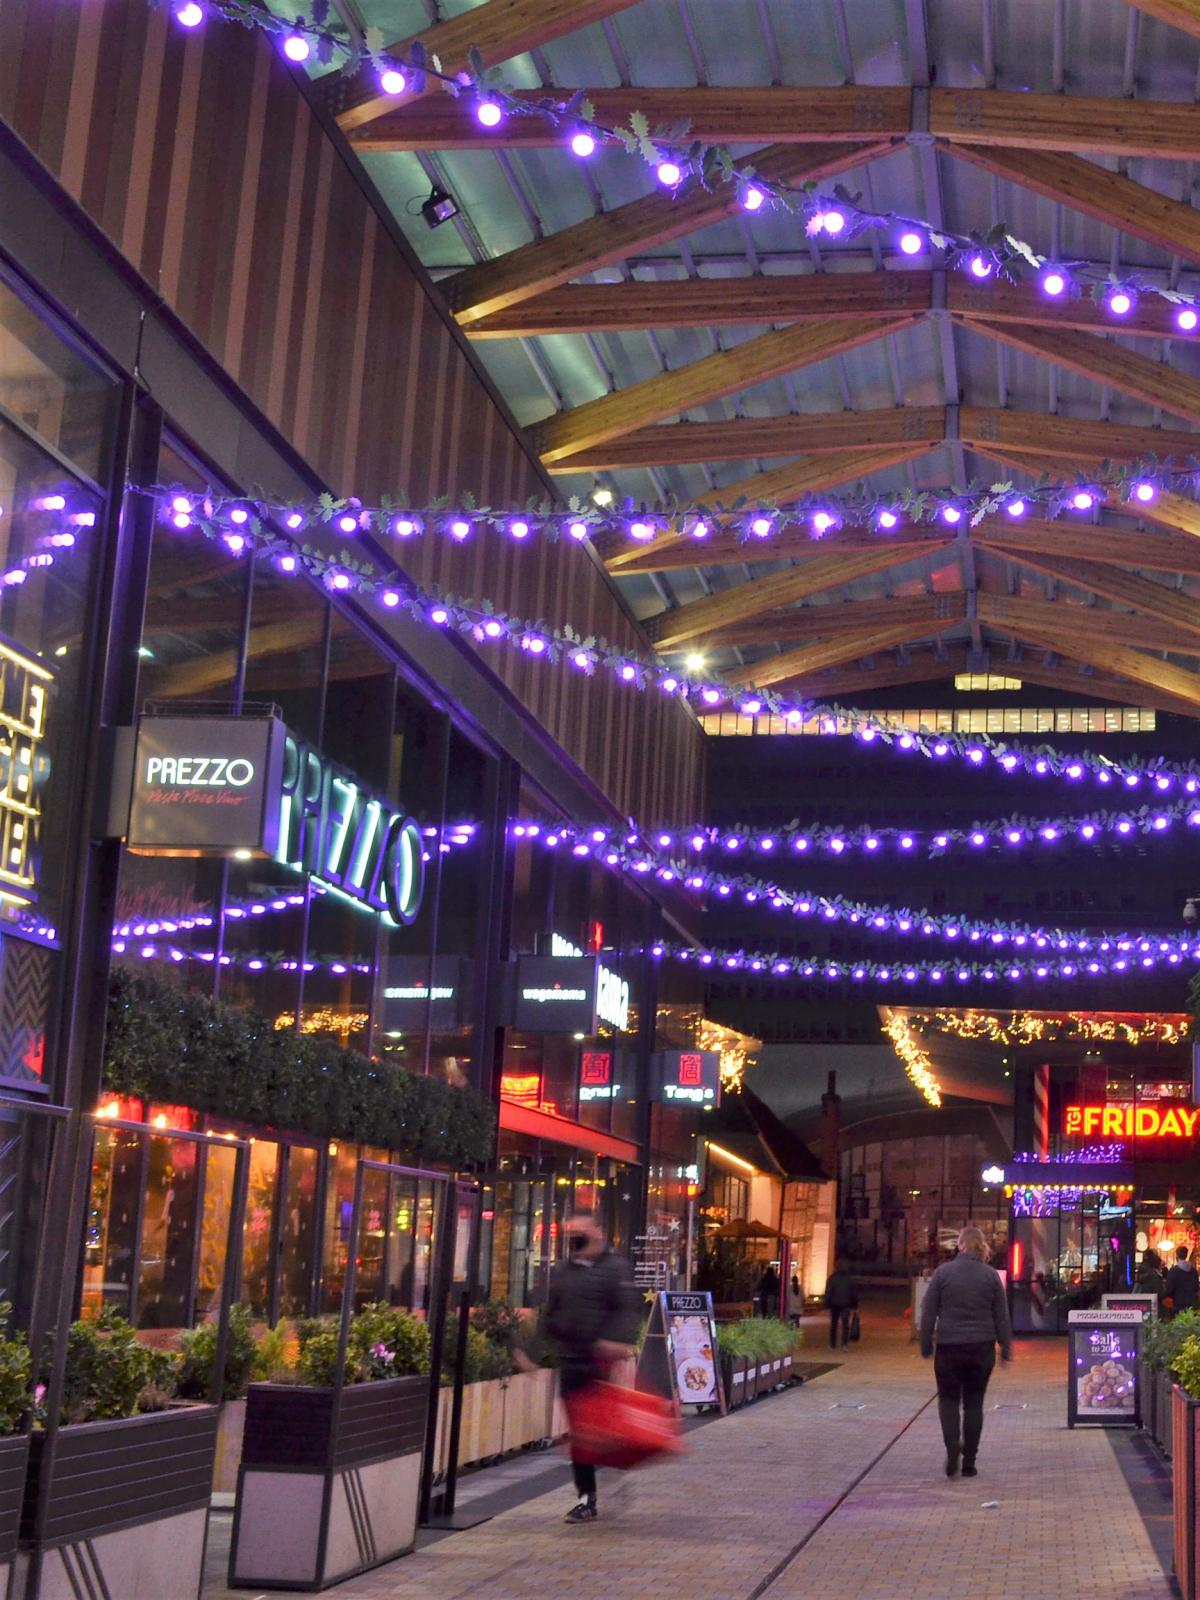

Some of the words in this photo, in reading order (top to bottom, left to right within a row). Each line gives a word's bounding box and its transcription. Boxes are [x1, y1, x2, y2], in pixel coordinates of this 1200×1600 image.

[146, 757, 254, 786] PREZZO
[522, 988, 587, 1002] wagamama
[664, 1085, 714, 1103] Tang's
[1066, 1106, 1082, 1135] TGI
[671, 1295, 702, 1310] PREZZO
